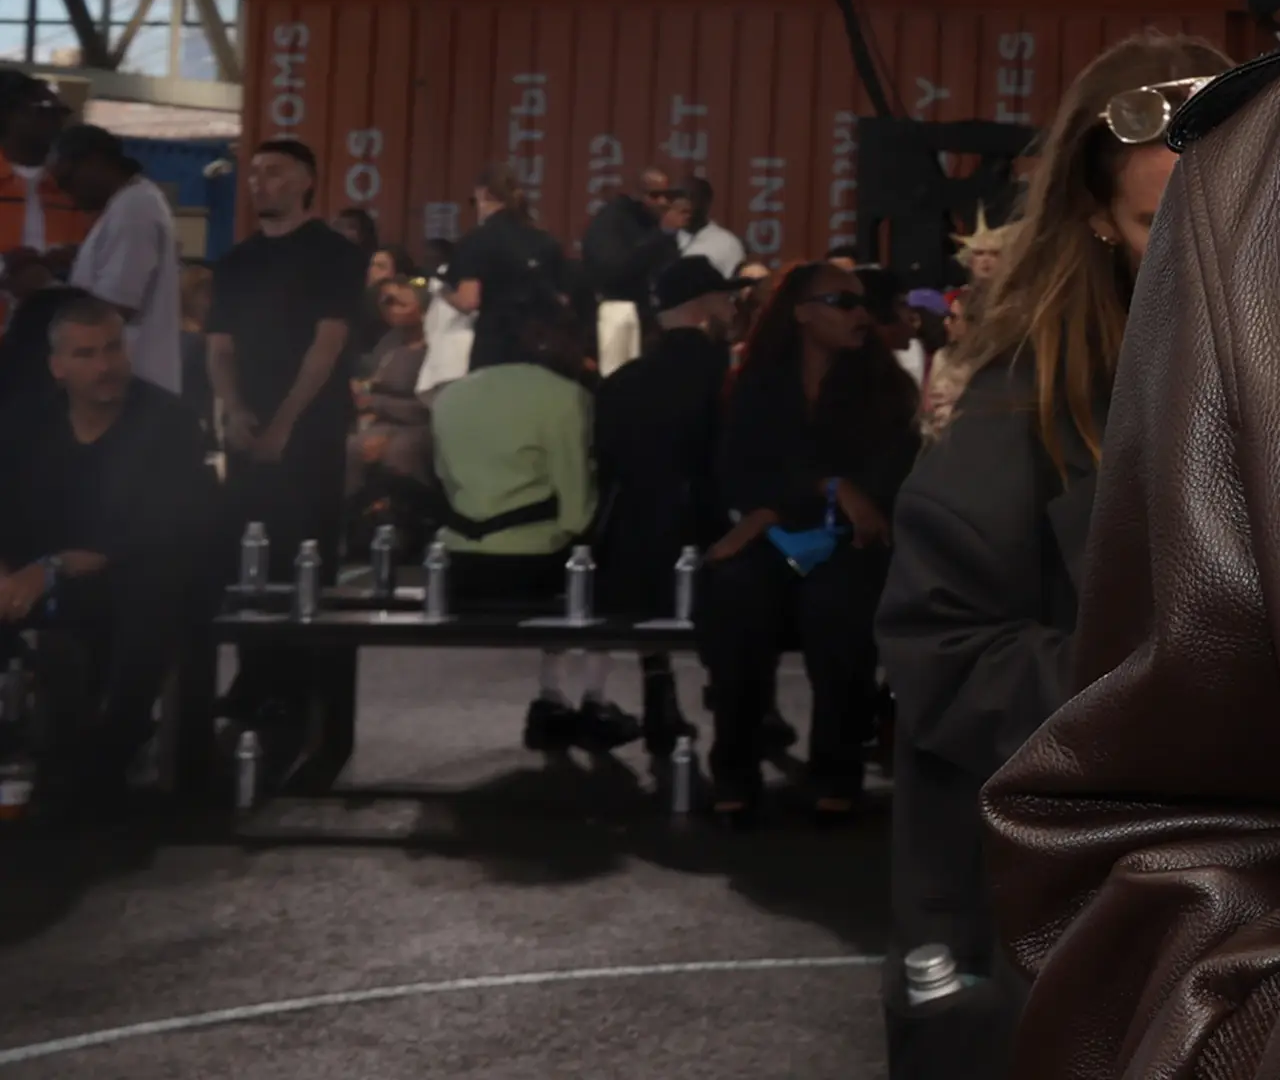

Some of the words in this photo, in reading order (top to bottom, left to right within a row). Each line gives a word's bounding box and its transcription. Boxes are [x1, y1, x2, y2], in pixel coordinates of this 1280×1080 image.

[270, 22, 310, 140] OMS
[345, 127, 385, 219] OS
[745, 156, 788, 269] GNI
